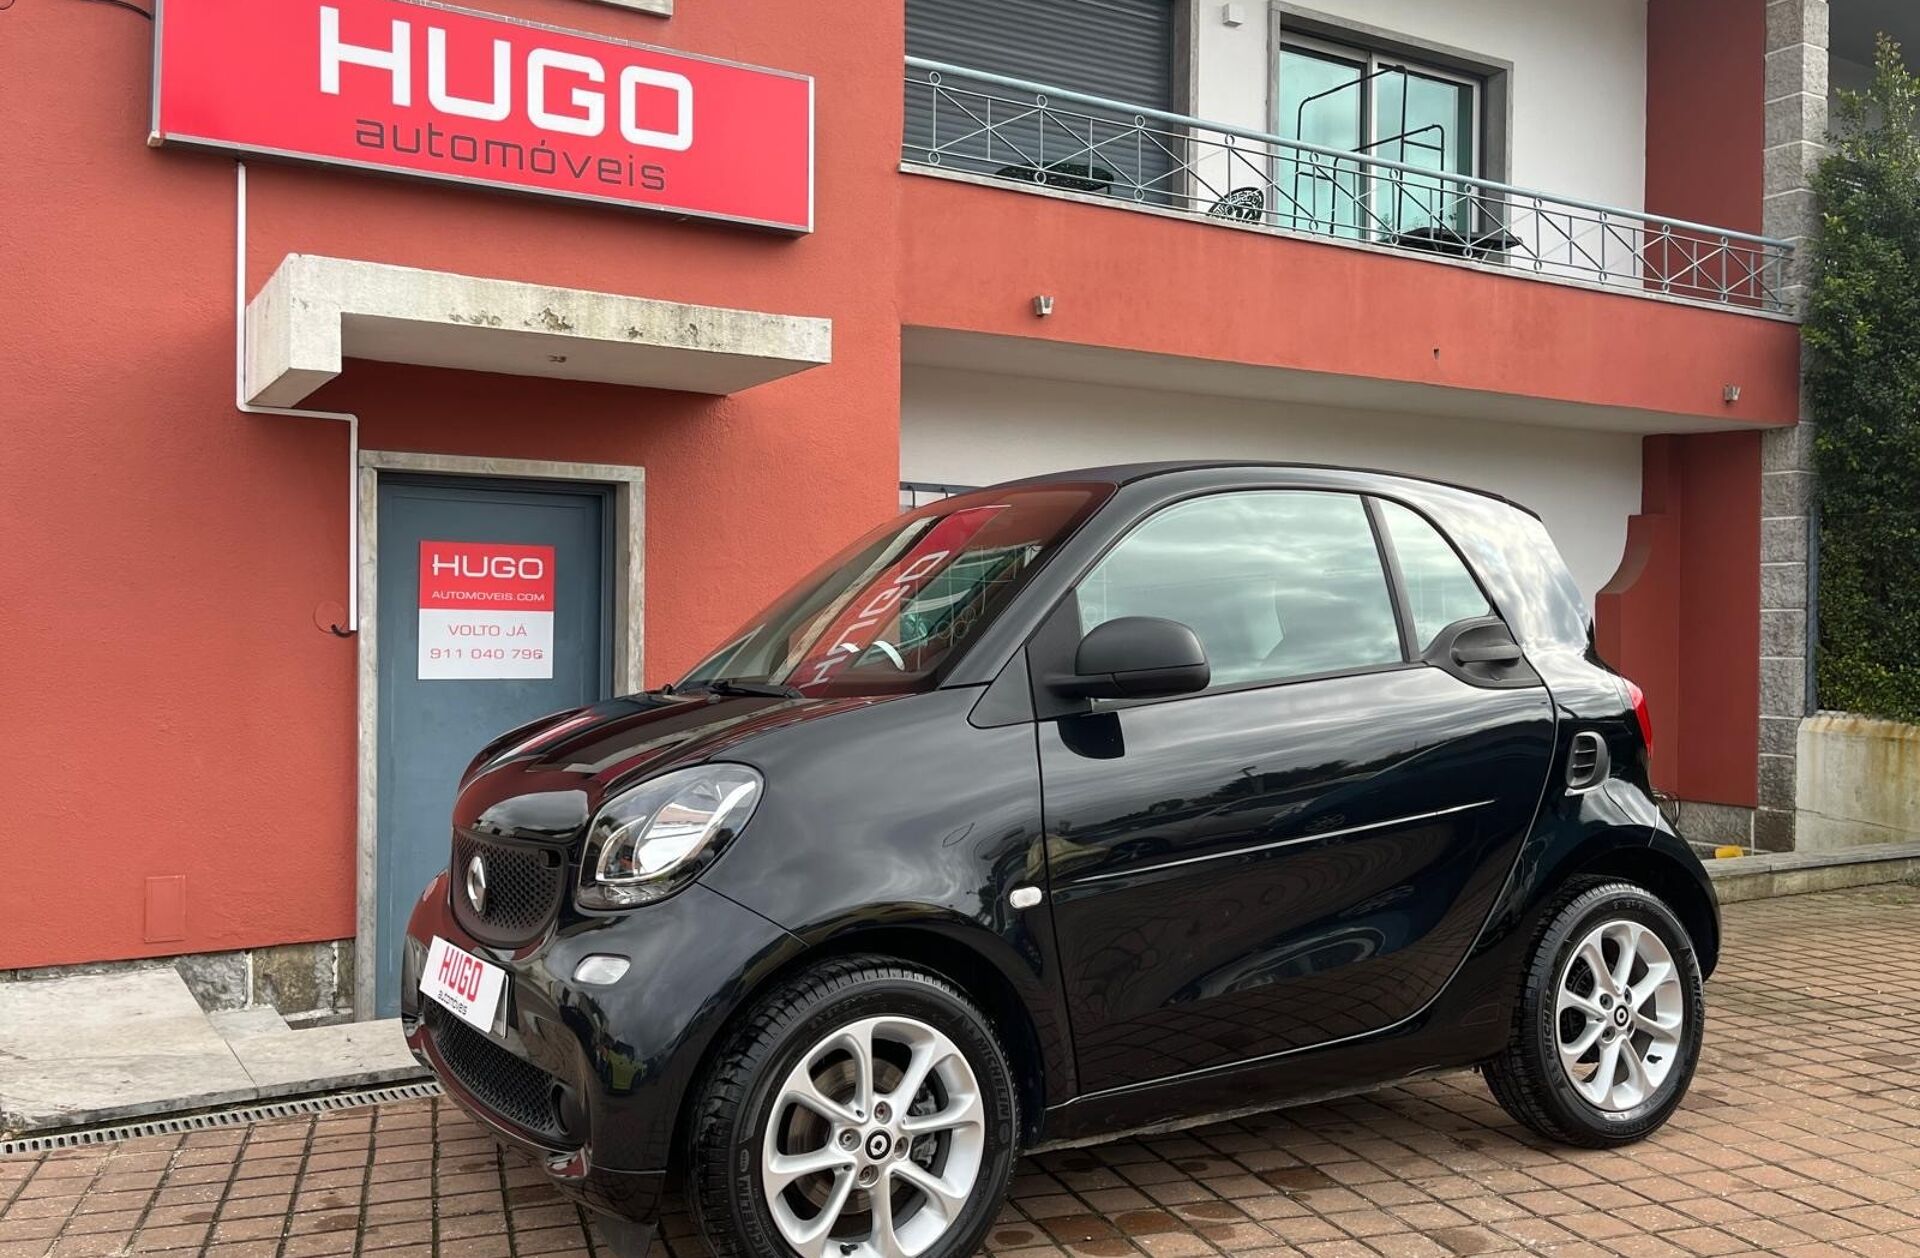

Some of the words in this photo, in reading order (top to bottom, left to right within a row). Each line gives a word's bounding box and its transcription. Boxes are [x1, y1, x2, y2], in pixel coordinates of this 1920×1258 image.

[319, 5, 694, 152] HUGO
[355, 118, 665, 191] automóveis
[432, 553, 544, 580] HUGO
[448, 624, 500, 636] VOLTO
[430, 648, 462, 659] 911
[471, 648, 505, 660] 040
[511, 649, 544, 660] 796
[438, 945, 484, 1003] HUGO
